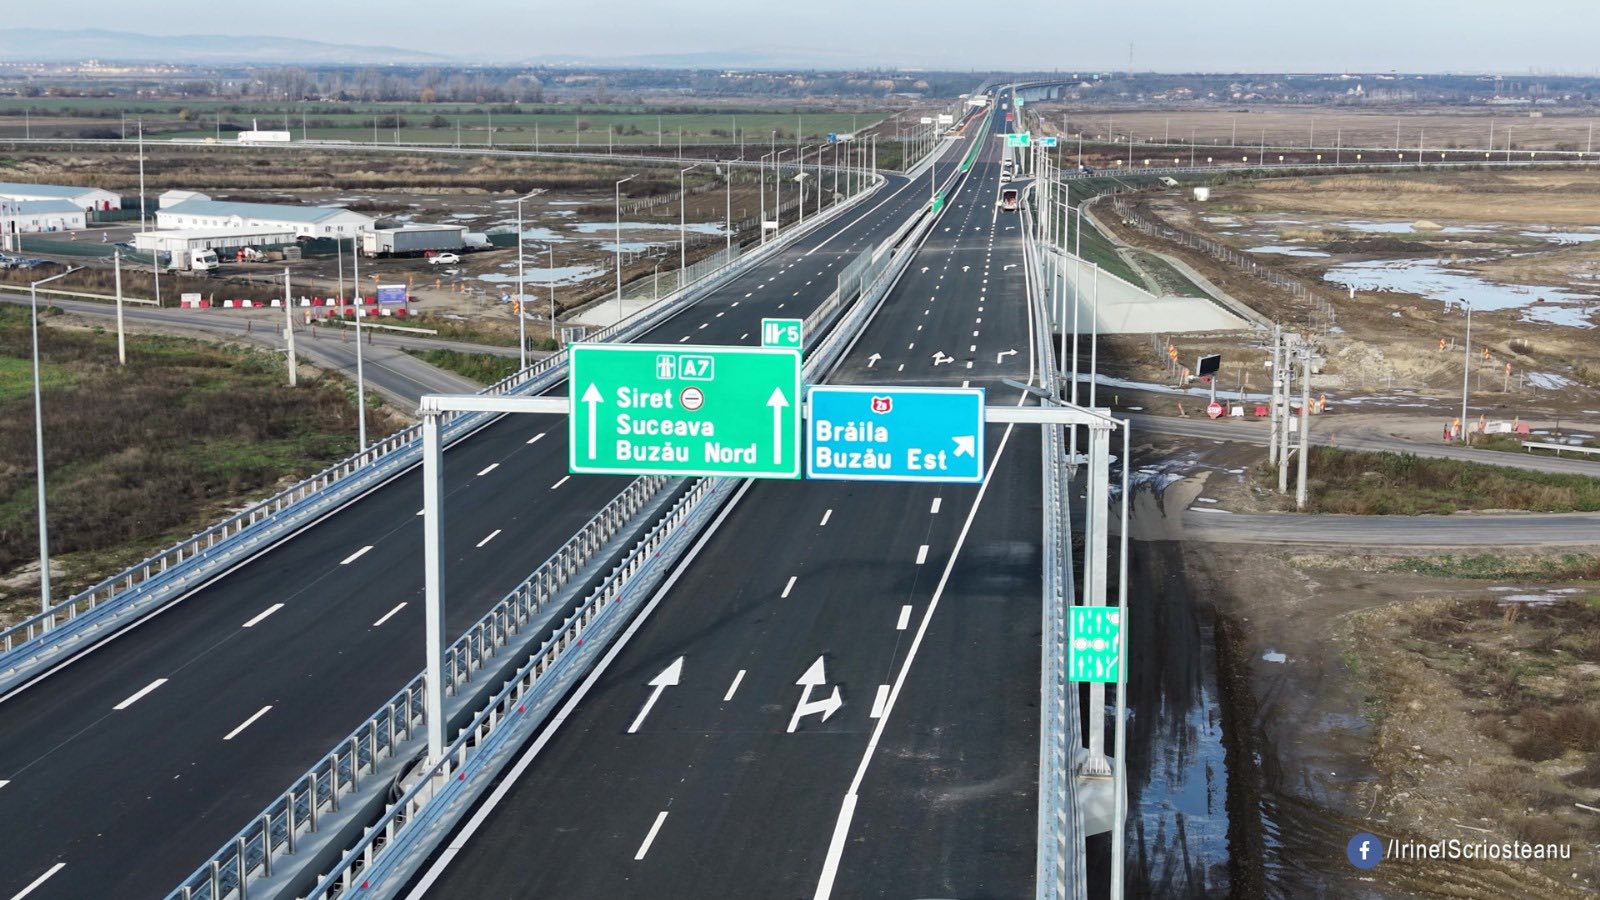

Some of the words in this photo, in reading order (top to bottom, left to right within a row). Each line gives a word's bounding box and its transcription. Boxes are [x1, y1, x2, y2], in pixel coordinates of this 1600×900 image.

[787, 326, 799, 343] 5
[683, 359, 710, 377] A7
[616, 387, 673, 409] Siret
[616, 414, 715, 437] Suceava
[816, 419, 888, 443] Brăila
[616, 440, 689, 463] Buzău
[704, 442, 757, 465] Nord
[816, 447, 892, 470] Buzău
[907, 449, 947, 471] Est
